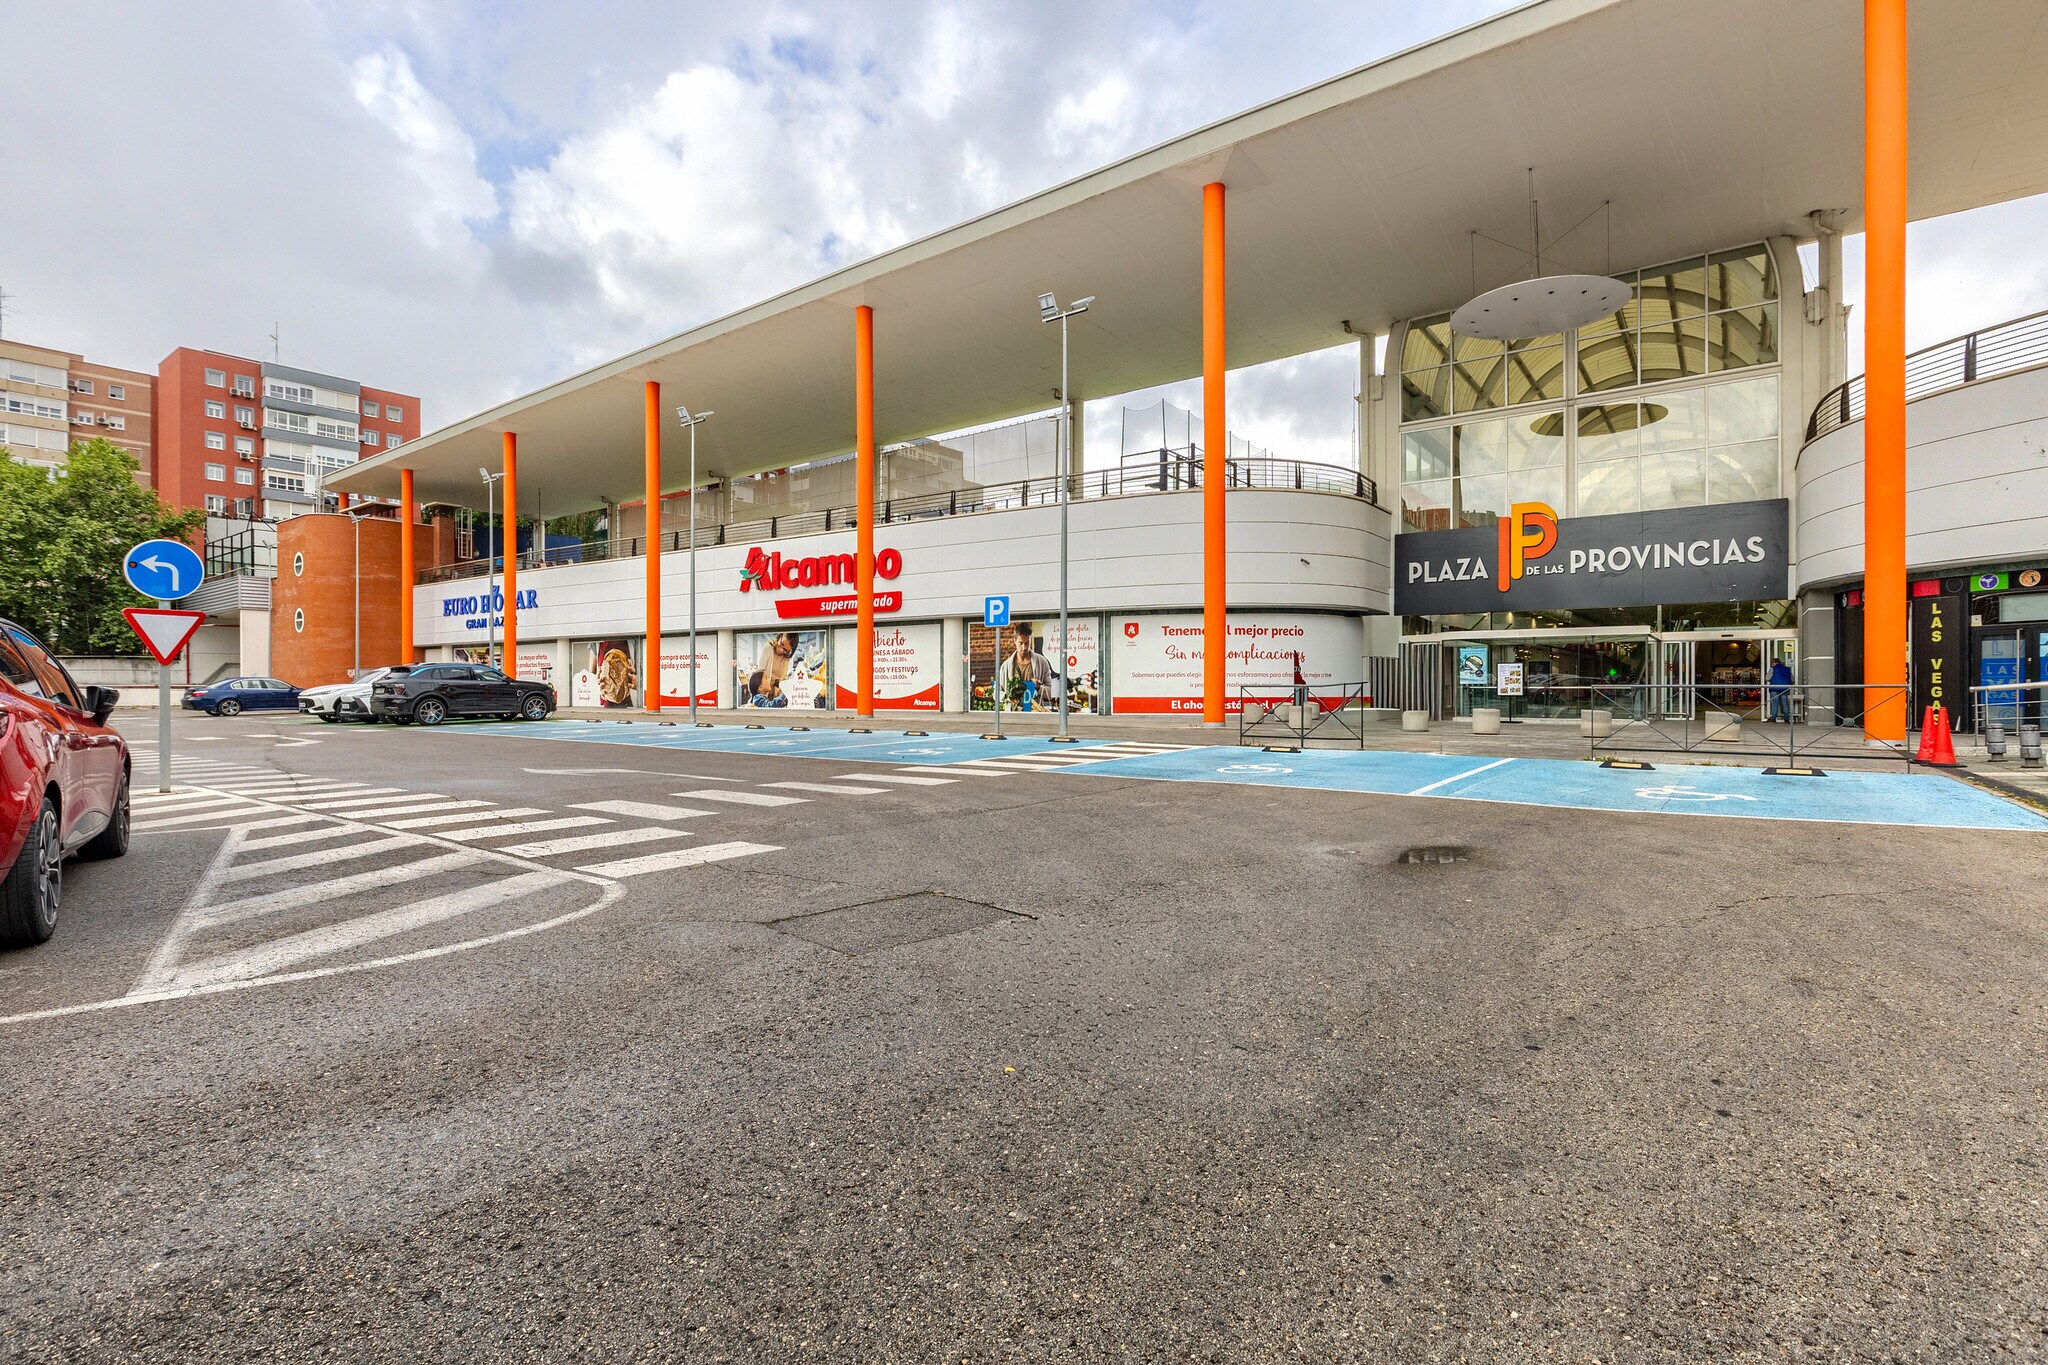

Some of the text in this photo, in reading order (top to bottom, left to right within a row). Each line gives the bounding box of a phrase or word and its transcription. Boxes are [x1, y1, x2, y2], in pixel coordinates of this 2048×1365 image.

[1408, 535, 1766, 584] PLAZA DE LAS PROVINCIAS
[442, 588, 539, 617] EURO HOAR
[820, 594, 894, 614] supermado
[989, 599, 1005, 623] P
[466, 618, 487, 630] GRAN
[1930, 602, 1943, 643] LAS
[1161, 625, 1204, 636] Tenem
[1234, 624, 1269, 639] mejor
[1271, 625, 1304, 639] precio
[891, 647, 915, 656] SÁBADO
[1165, 644, 1187, 660] Sin
[891, 665, 919, 673] FESTIVOS
[1166, 671, 1186, 679] puedes
[913, 698, 937, 707] Alcampo
[1171, 700, 1180, 709] El
